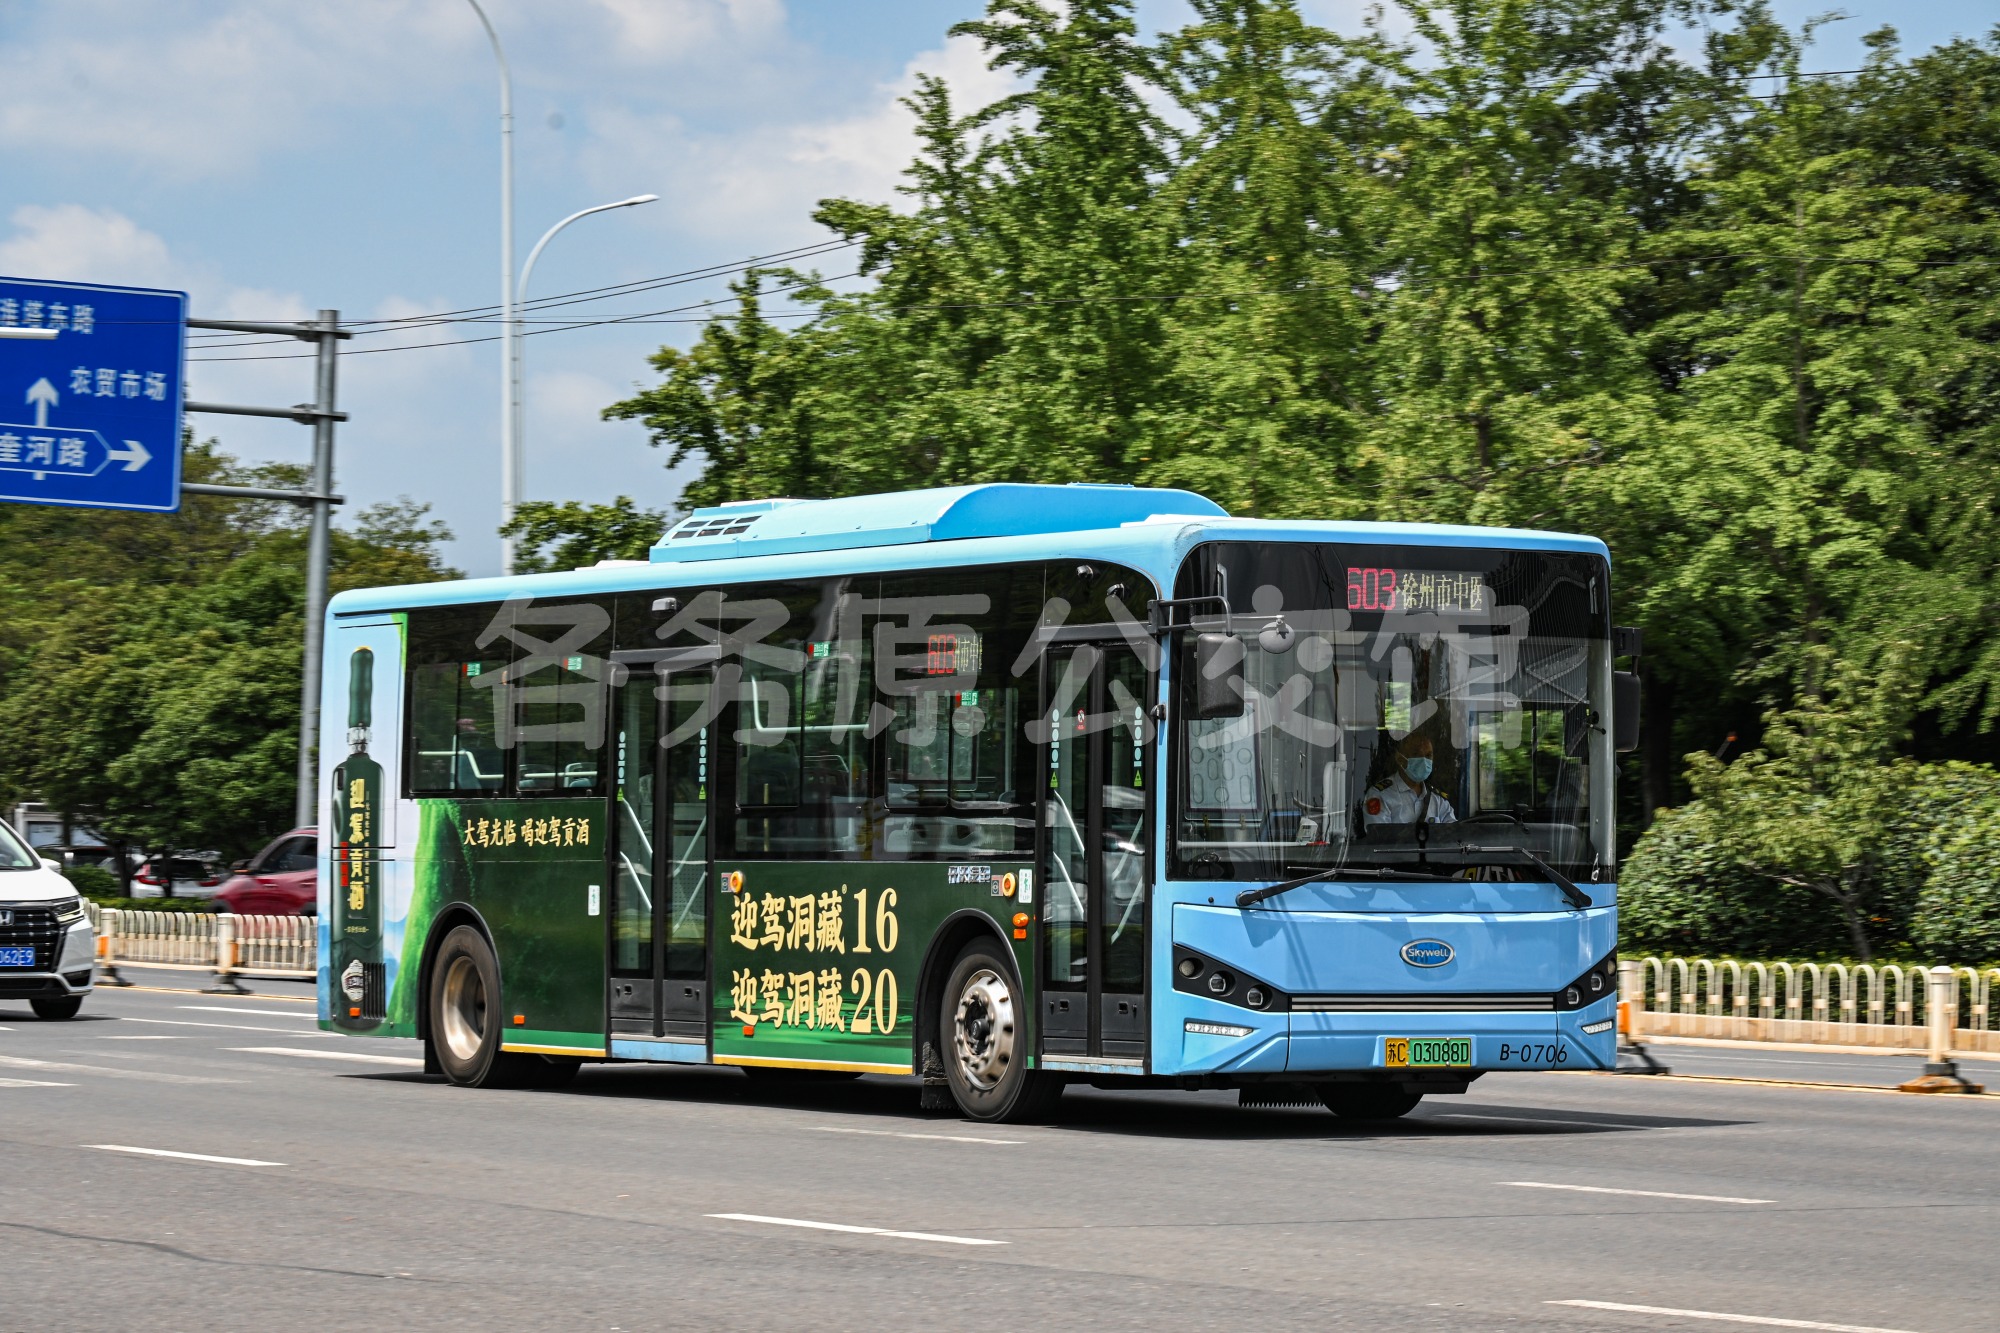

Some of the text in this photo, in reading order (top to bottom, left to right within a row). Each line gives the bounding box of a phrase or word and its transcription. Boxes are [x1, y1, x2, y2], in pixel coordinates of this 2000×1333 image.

[69, 366, 167, 401] 农贸市场
[0, 432, 87, 468] 奎河路
[1347, 567, 1482, 611] 603 徐州市中医
[463, 816, 589, 848] 大驾光临 喝迎驾贡酒
[1408, 947, 1448, 959] Skywell
[1500, 1043, 1568, 1063] B-0706
